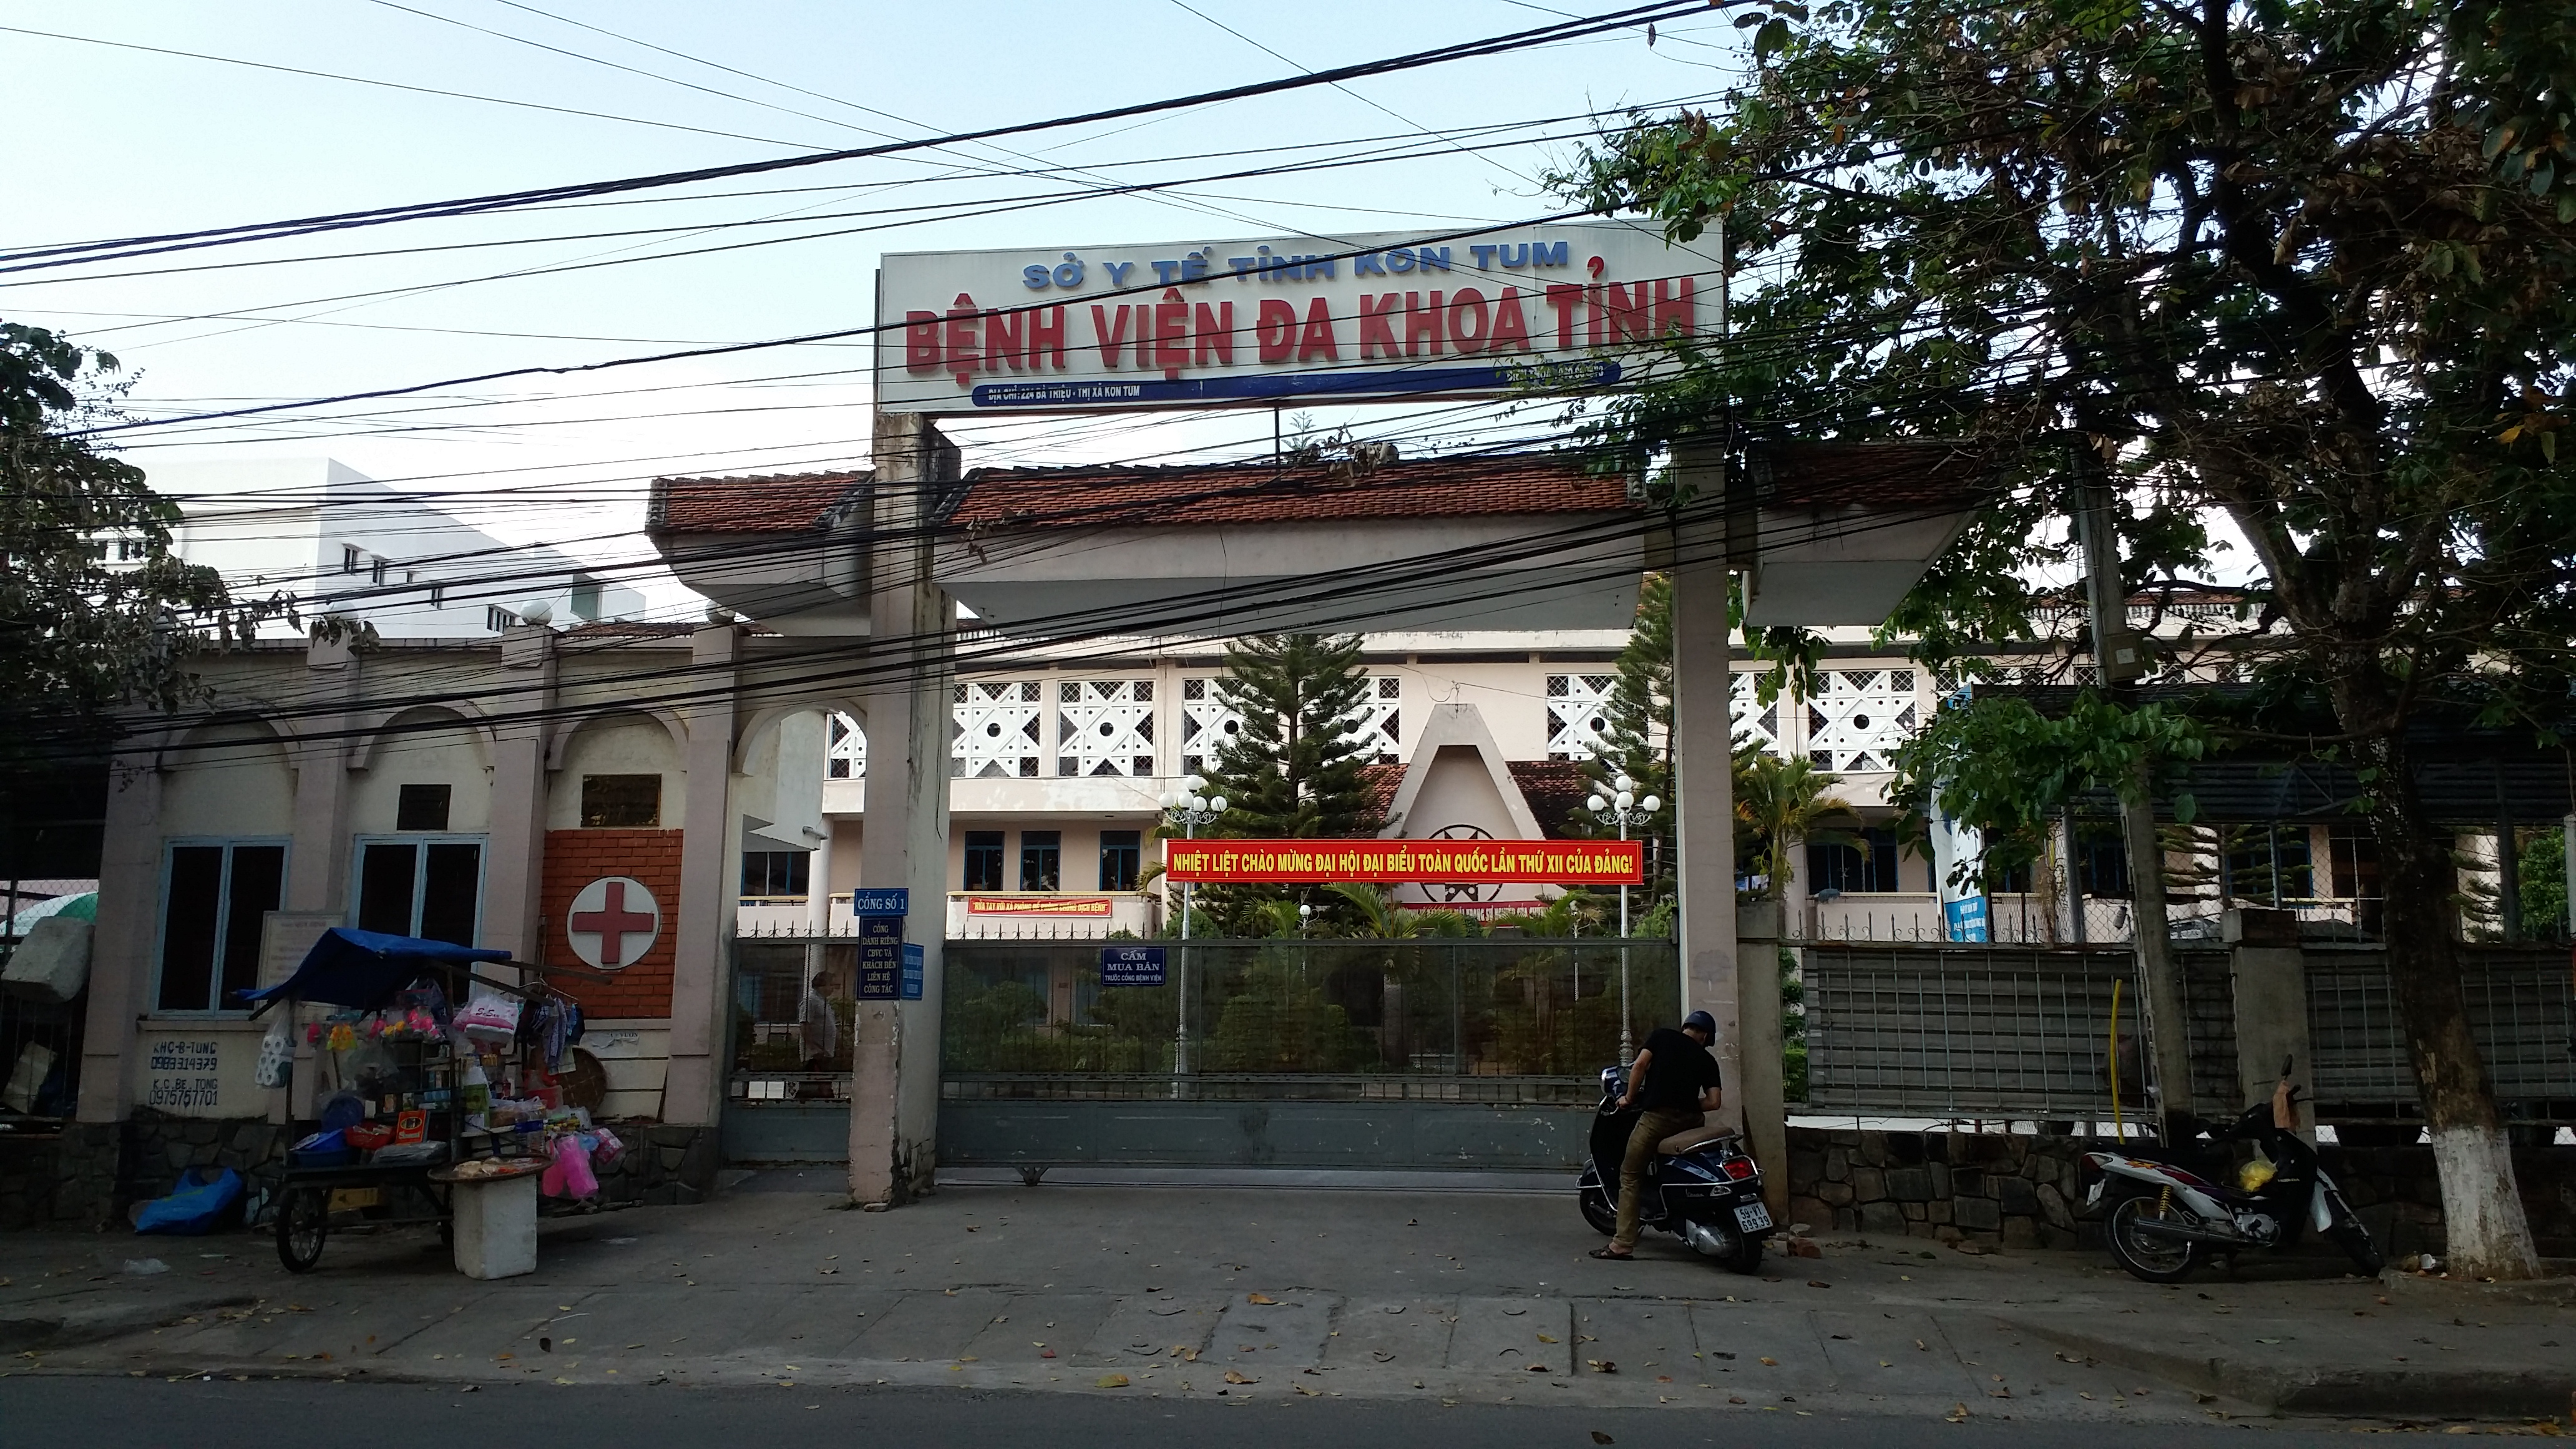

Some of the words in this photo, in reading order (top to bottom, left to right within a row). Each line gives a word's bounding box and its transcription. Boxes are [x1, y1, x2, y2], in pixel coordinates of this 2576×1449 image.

[1023, 252, 1085, 289] SỞ
[1102, 262, 1133, 286] Y
[1151, 246, 1212, 285] TẾ
[1228, 245, 1335, 281] TỈNH
[1354, 246, 1450, 276] KON
[1470, 242, 1568, 271] TUM
[906, 293, 1065, 386] BỆNH
[1091, 288, 1233, 380] VIỆN
[1257, 296, 1339, 364] ĐA
[1359, 287, 1531, 359] KHOA
[1546, 256, 1694, 348] TỈNH
[1078, 388, 1091, 401] THỊ
[1092, 383, 1102, 398] XÃ
[1105, 386, 1121, 397] KON
[1123, 385, 1140, 396] TUM
[1173, 849, 1209, 877] NHIỆT
[1212, 850, 1239, 877] LIỆT
[1241, 848, 1274, 872] CHÀO
[1278, 849, 1312, 872] MỪNG
[1315, 853, 1335, 877] ĐẠI
[1339, 849, 1360, 877] HỘI
[1363, 853, 1383, 877] ĐẠI
[1387, 844, 1415, 872] BIỂU
[1418, 849, 1451, 872] TOÀN
[1454, 846, 1488, 873] QUỐC
[1491, 847, 1515, 873] LẦN
[1518, 849, 1544, 873] THỨ
[1546, 855, 1563, 873] XII
[1566, 847, 1591, 874] CỦA
[1594, 847, 1633, 874] ĐẢNG!
[857, 892, 883, 910] CỔNG
[886, 893, 897, 910] SỐ
[900, 899, 905, 909] 1
[873, 920, 889, 934] CỔNG
[862, 935, 879, 945] DÀNH
[880, 935, 898, 945] RIÊNG
[867, 949, 883, 957] CBVC
[884, 947, 892, 957] VÀ
[1120, 949, 1147, 960] CẤM
[862, 959, 883, 969] KHÁCH
[884, 957, 897, 968] ĐẾN
[1106, 963, 1133, 971] MUA
[1136, 961, 1160, 971] BÁN
[867, 971, 881, 982] LIÊN
[882, 971, 890, 983] HỆ
[1105, 973, 1121, 982] TRƯỚC
[1121, 972, 1135, 982] CỔNG
[1136, 973, 1149, 983] BỆNH
[1150, 973, 1162, 983] VIỆN
[864, 983, 879, 993] CÔNG
[881, 983, 894, 993] TÁC
[151, 1056, 217, 1070] 0983314379
[150, 1090, 217, 1106] 0975757701
[1742, 1215, 1770, 1231] 699.39
